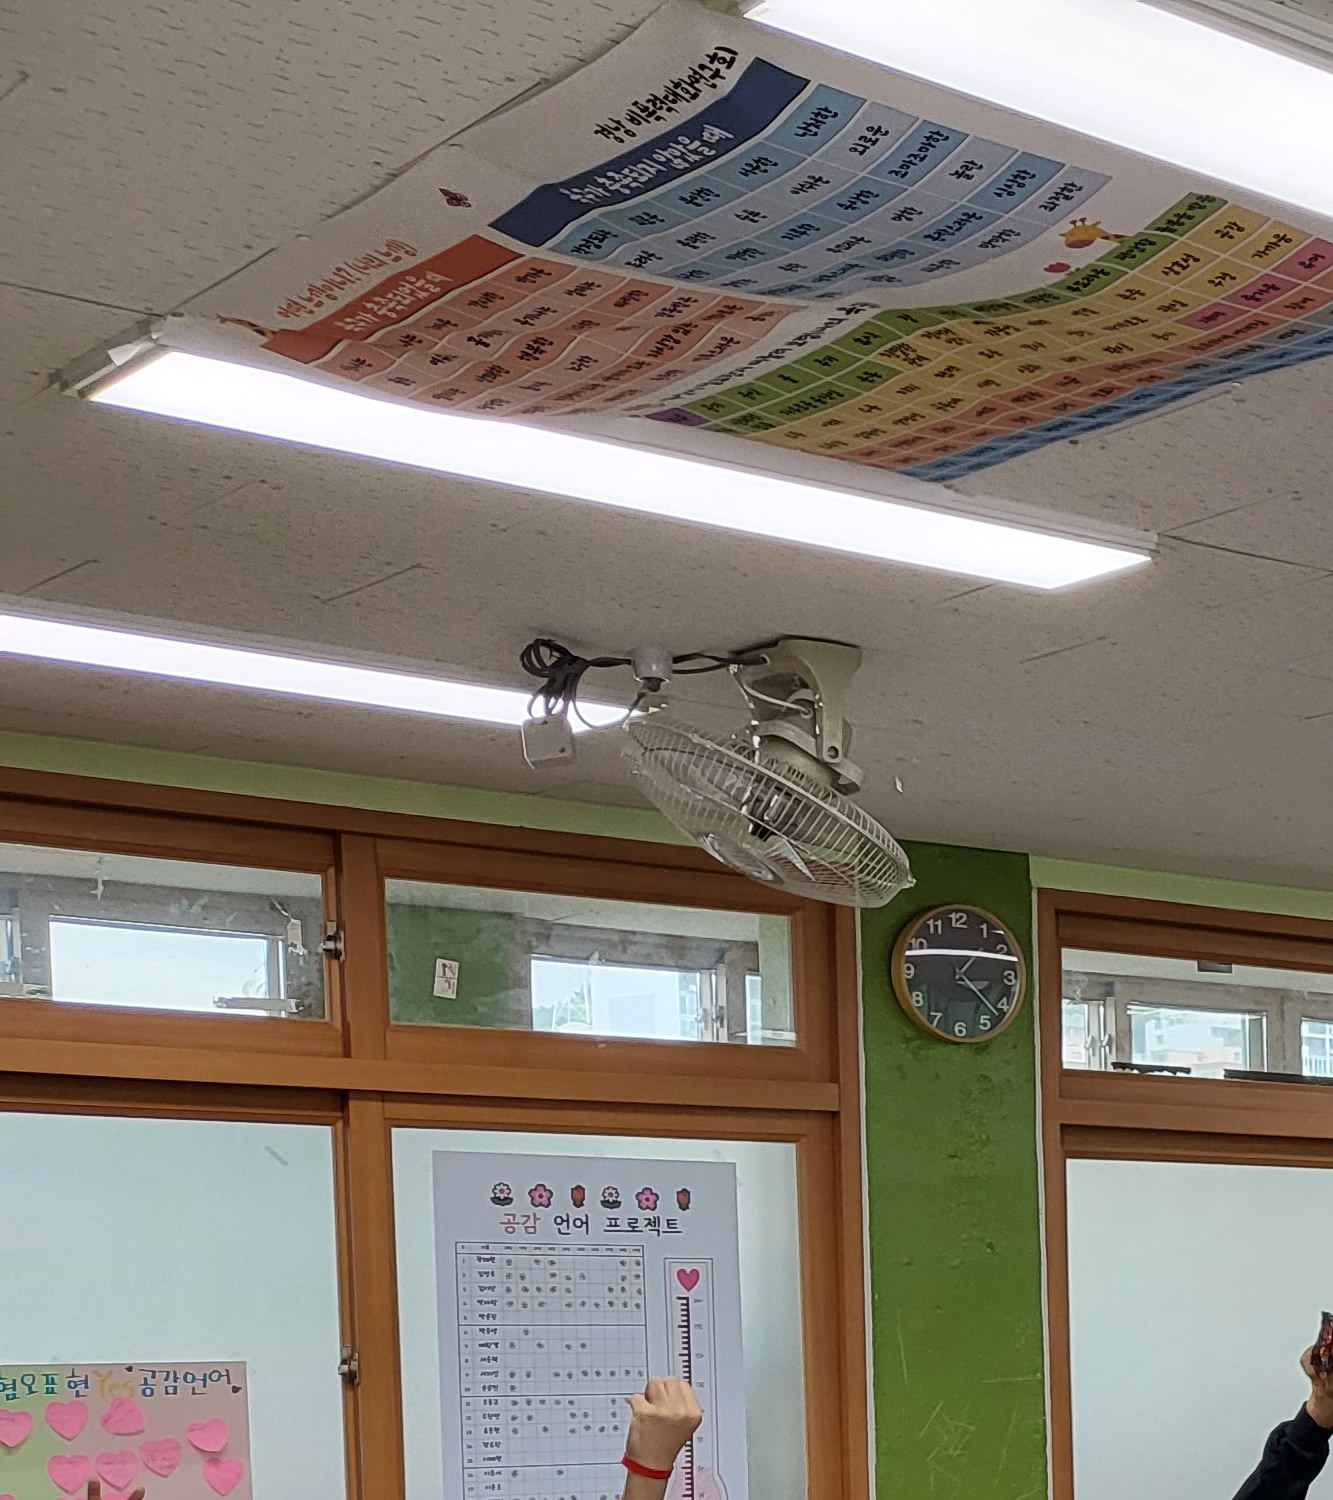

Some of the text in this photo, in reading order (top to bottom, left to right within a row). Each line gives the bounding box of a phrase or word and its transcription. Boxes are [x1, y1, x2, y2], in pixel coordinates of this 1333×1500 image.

[594, 46, 739, 145] 경남 비폭력대화연구회
[848, 125, 889, 155] 외로운
[596, 159, 664, 193] 충족되지
[653, 136, 714, 168] 않았을
[702, 124, 733, 142] 때
[889, 128, 951, 178] 조마조마한
[949, 160, 983, 180] 놀란
[993, 169, 1036, 197] 심심한
[1213, 221, 1245, 239] 공감
[646, 333, 681, 358] 자신감
[926, 918, 943, 935] 11
[948, 912, 968, 929] 12
[979, 923, 988, 938] 1
[903, 964, 915, 979] 9
[1003, 970, 1016, 986] 3
[912, 992, 924, 1006] 8
[996, 997, 1009, 1012] 4
[930, 1012, 943, 1027] 7
[954, 1021, 966, 1036] 6
[979, 1015, 991, 1030] 5
[500, 1212, 683, 1237] 공감 언어 프로젝트
[92, 1369, 135, 1399] Yes
[139, 1369, 232, 1398] 공감언어
